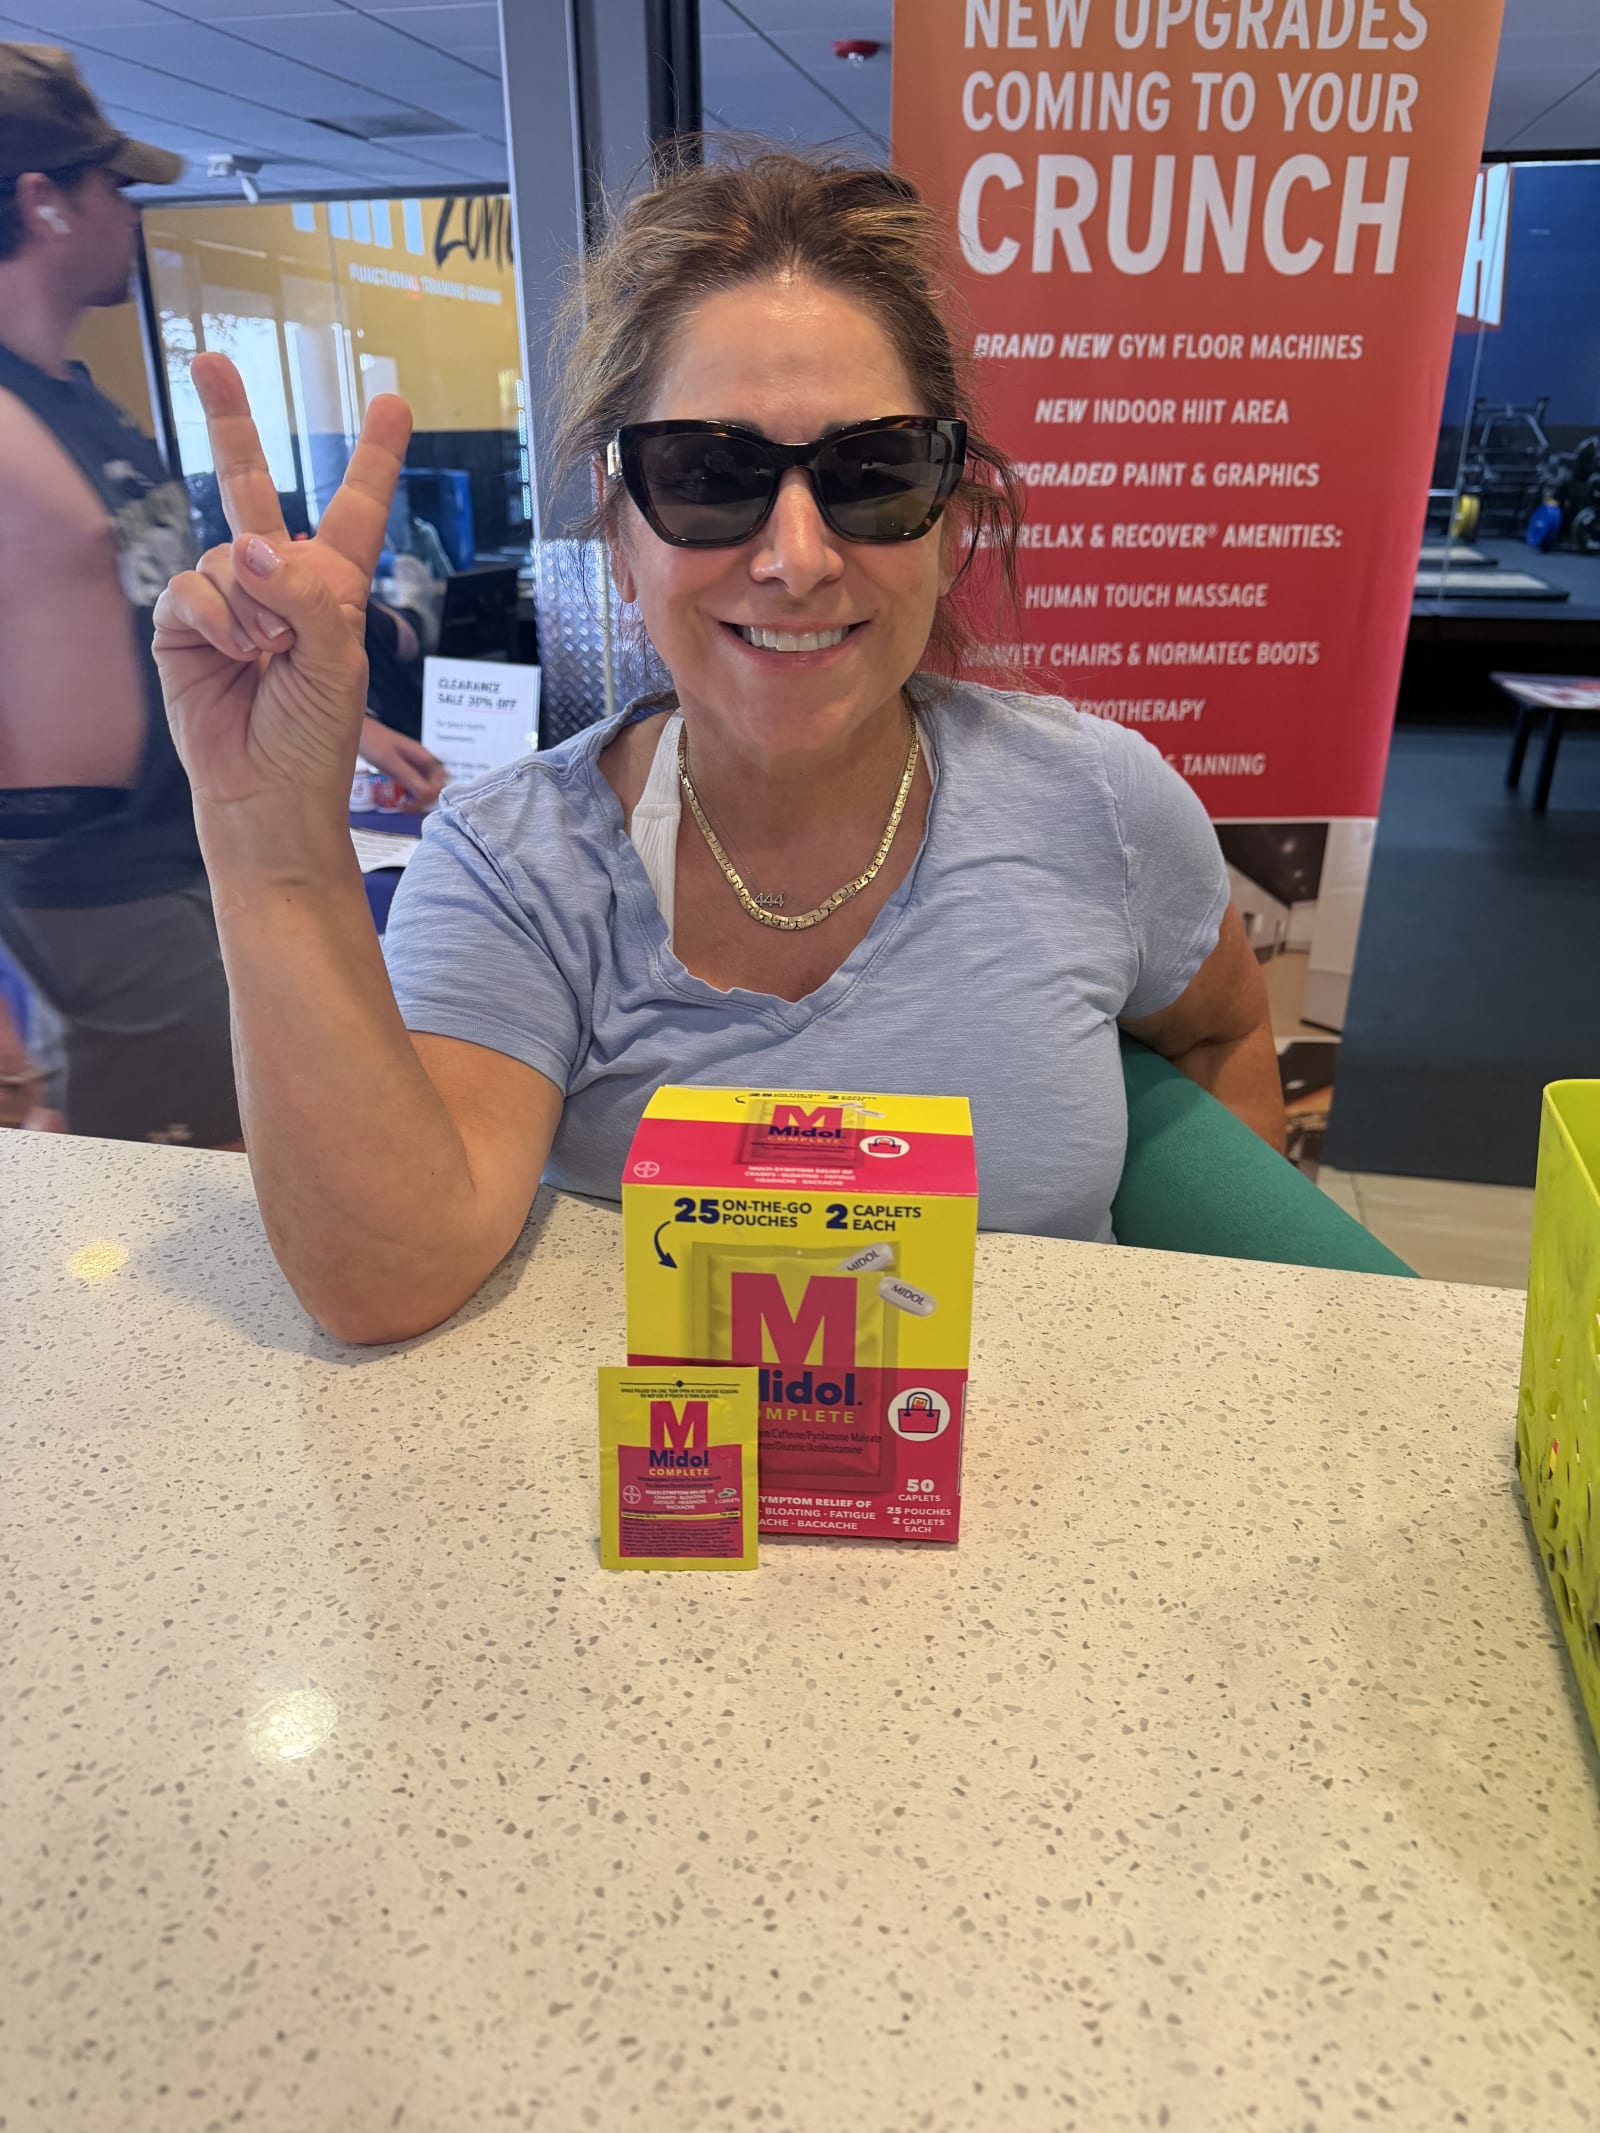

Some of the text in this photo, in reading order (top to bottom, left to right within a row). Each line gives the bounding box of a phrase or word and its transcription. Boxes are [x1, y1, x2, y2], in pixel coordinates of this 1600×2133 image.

[963, 0, 1428, 50] NEW UPGRADES
[963, 71, 1419, 133] COMING TO YOUR
[957, 152, 1410, 275] CRUNCH
[974, 333, 1364, 361] BRAND NEW GYM FLOOR MACHINES
[1035, 398, 1088, 424] NEW
[1093, 398, 1176, 425] INDOOR
[1231, 399, 1289, 425] AREA
[1123, 462, 1186, 487] PAINT
[1191, 463, 1206, 487] &
[1212, 463, 1320, 488] GRAPHICS
[1018, 525, 1085, 548] RELAX
[1090, 525, 1105, 548] &
[1222, 525, 1343, 550] AMENITIES:
[1025, 584, 1268, 609] HUMAN TOUCH MASSAGE
[1050, 643, 1123, 667] CHAIRS
[1127, 644, 1141, 667] &
[1147, 643, 1251, 667] NORMATEC
[1256, 642, 1320, 666] BOOTS
[1076, 699, 1206, 722] RYOTHERAPY
[1182, 754, 1266, 776] TANNING
[771, 1105, 844, 1129] M
[768, 1126, 842, 1139] Midol
[674, 1198, 720, 1224] 25
[722, 1199, 812, 1215] ON-THE-GO
[826, 1204, 848, 1229] 2
[853, 1205, 922, 1218] CAPLETS
[722, 1214, 798, 1228] POUCHES
[852, 1220, 896, 1231] EACH
[846, 1250, 881, 1271] MIDOL
[890, 1283, 926, 1307] MIDOL
[731, 1272, 858, 1367] M
[650, 1401, 708, 1448] M
[758, 1407, 855, 1424] MPLETE
[649, 1450, 708, 1467] Midol
[649, 1468, 710, 1476] COMPLETE
[906, 1478, 935, 1493] 50
[816, 1499, 853, 1508] RELIEF
[856, 1500, 872, 1508] OF
[898, 1494, 941, 1502] CAPLETS
[765, 1508, 876, 1520] BLOATING FATIGUE
[886, 1507, 952, 1516] 25 POUCHES
[892, 1517, 945, 1526] 2 CAPLETS
[759, 1518, 858, 1530] ACHE BACKACHE
